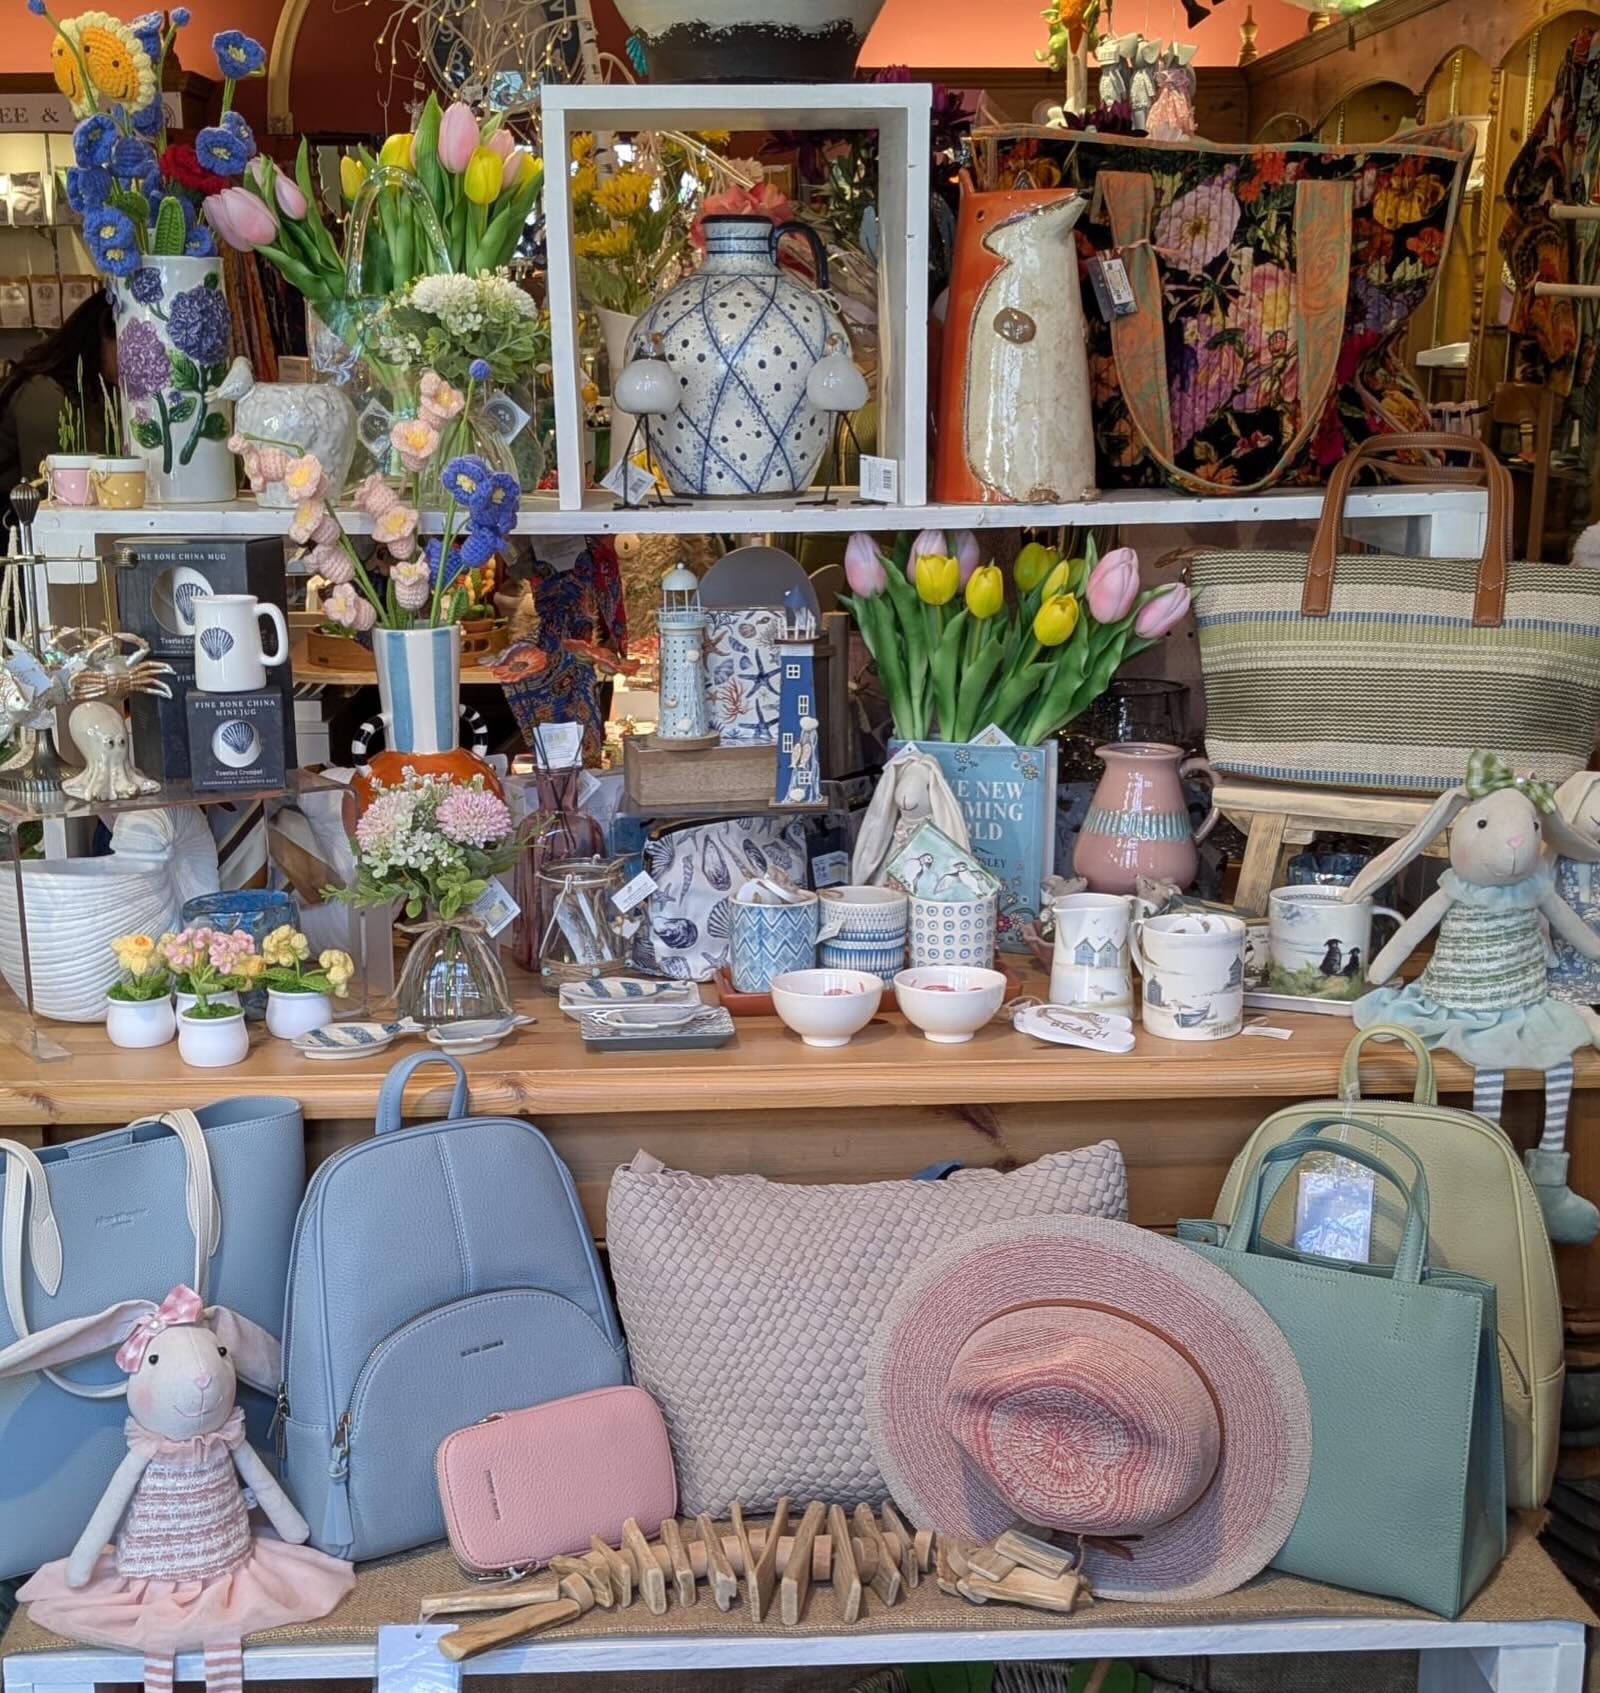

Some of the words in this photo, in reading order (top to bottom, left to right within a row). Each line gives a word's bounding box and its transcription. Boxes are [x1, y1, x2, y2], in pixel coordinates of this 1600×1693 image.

[42, 107, 59, 123] &
[154, 552, 176, 561] BONE
[178, 552, 204, 561] CHINA
[207, 552, 227, 561] MUG
[194, 701, 217, 709] FINE
[219, 700, 244, 708] BONE
[246, 699, 276, 707] CHINA
[215, 709, 238, 717] MINI
[240, 708, 257, 717] JUG
[976, 780, 1025, 800] NEW
[963, 801, 1025, 822] MING
[966, 821, 1003, 841] LD
